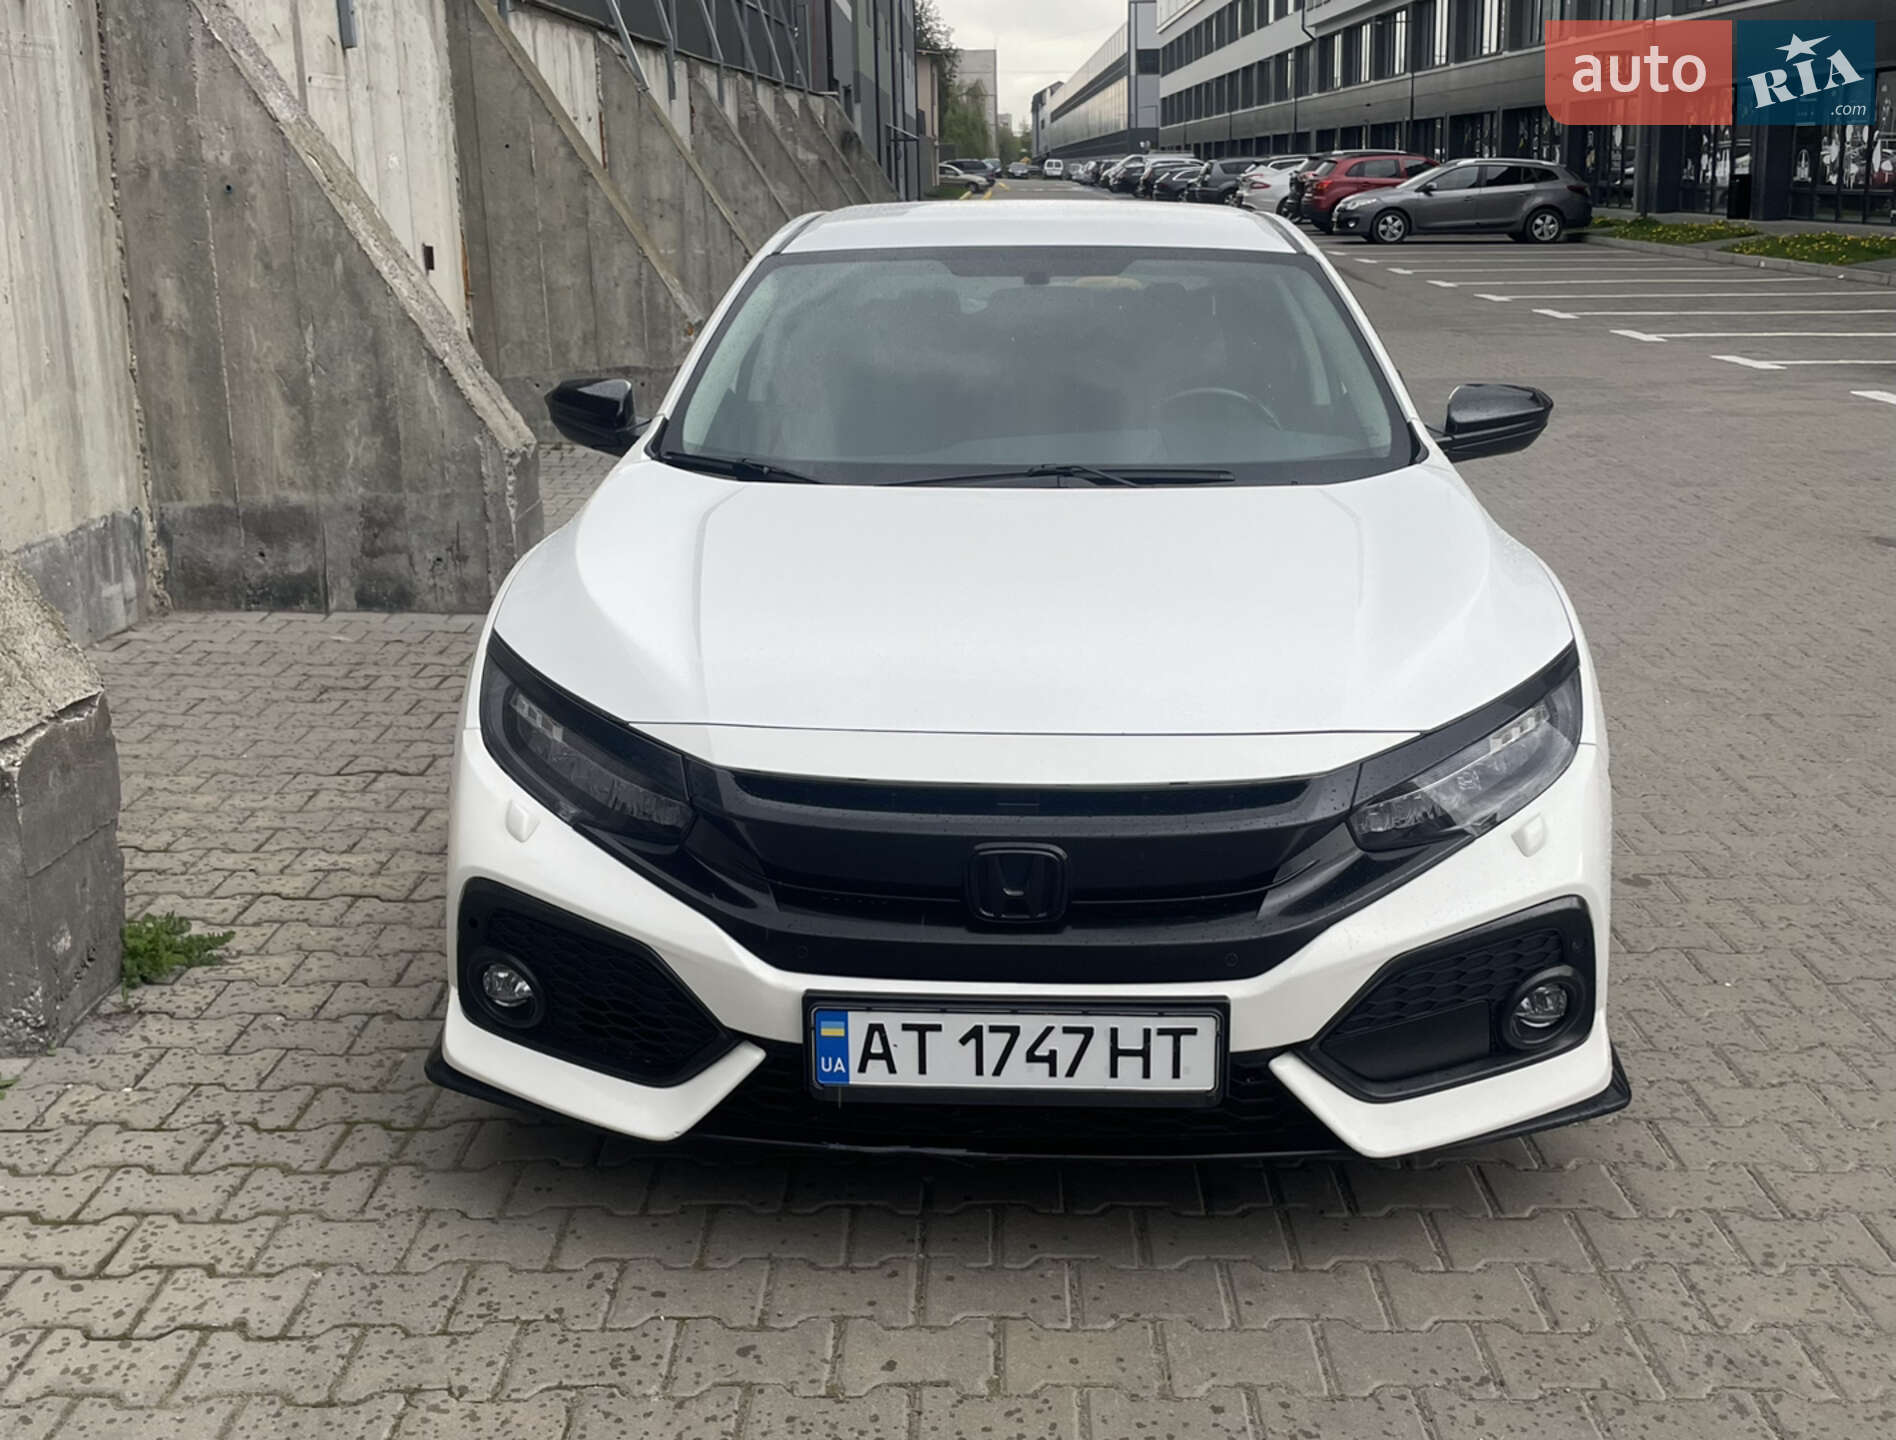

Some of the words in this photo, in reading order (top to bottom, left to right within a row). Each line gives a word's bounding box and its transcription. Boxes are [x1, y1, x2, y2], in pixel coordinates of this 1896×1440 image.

[821, 1058, 846, 1073] UA
[857, 1023, 942, 1076] AT
[958, 1024, 1094, 1078] 1747
[1110, 1027, 1198, 1079] HT
